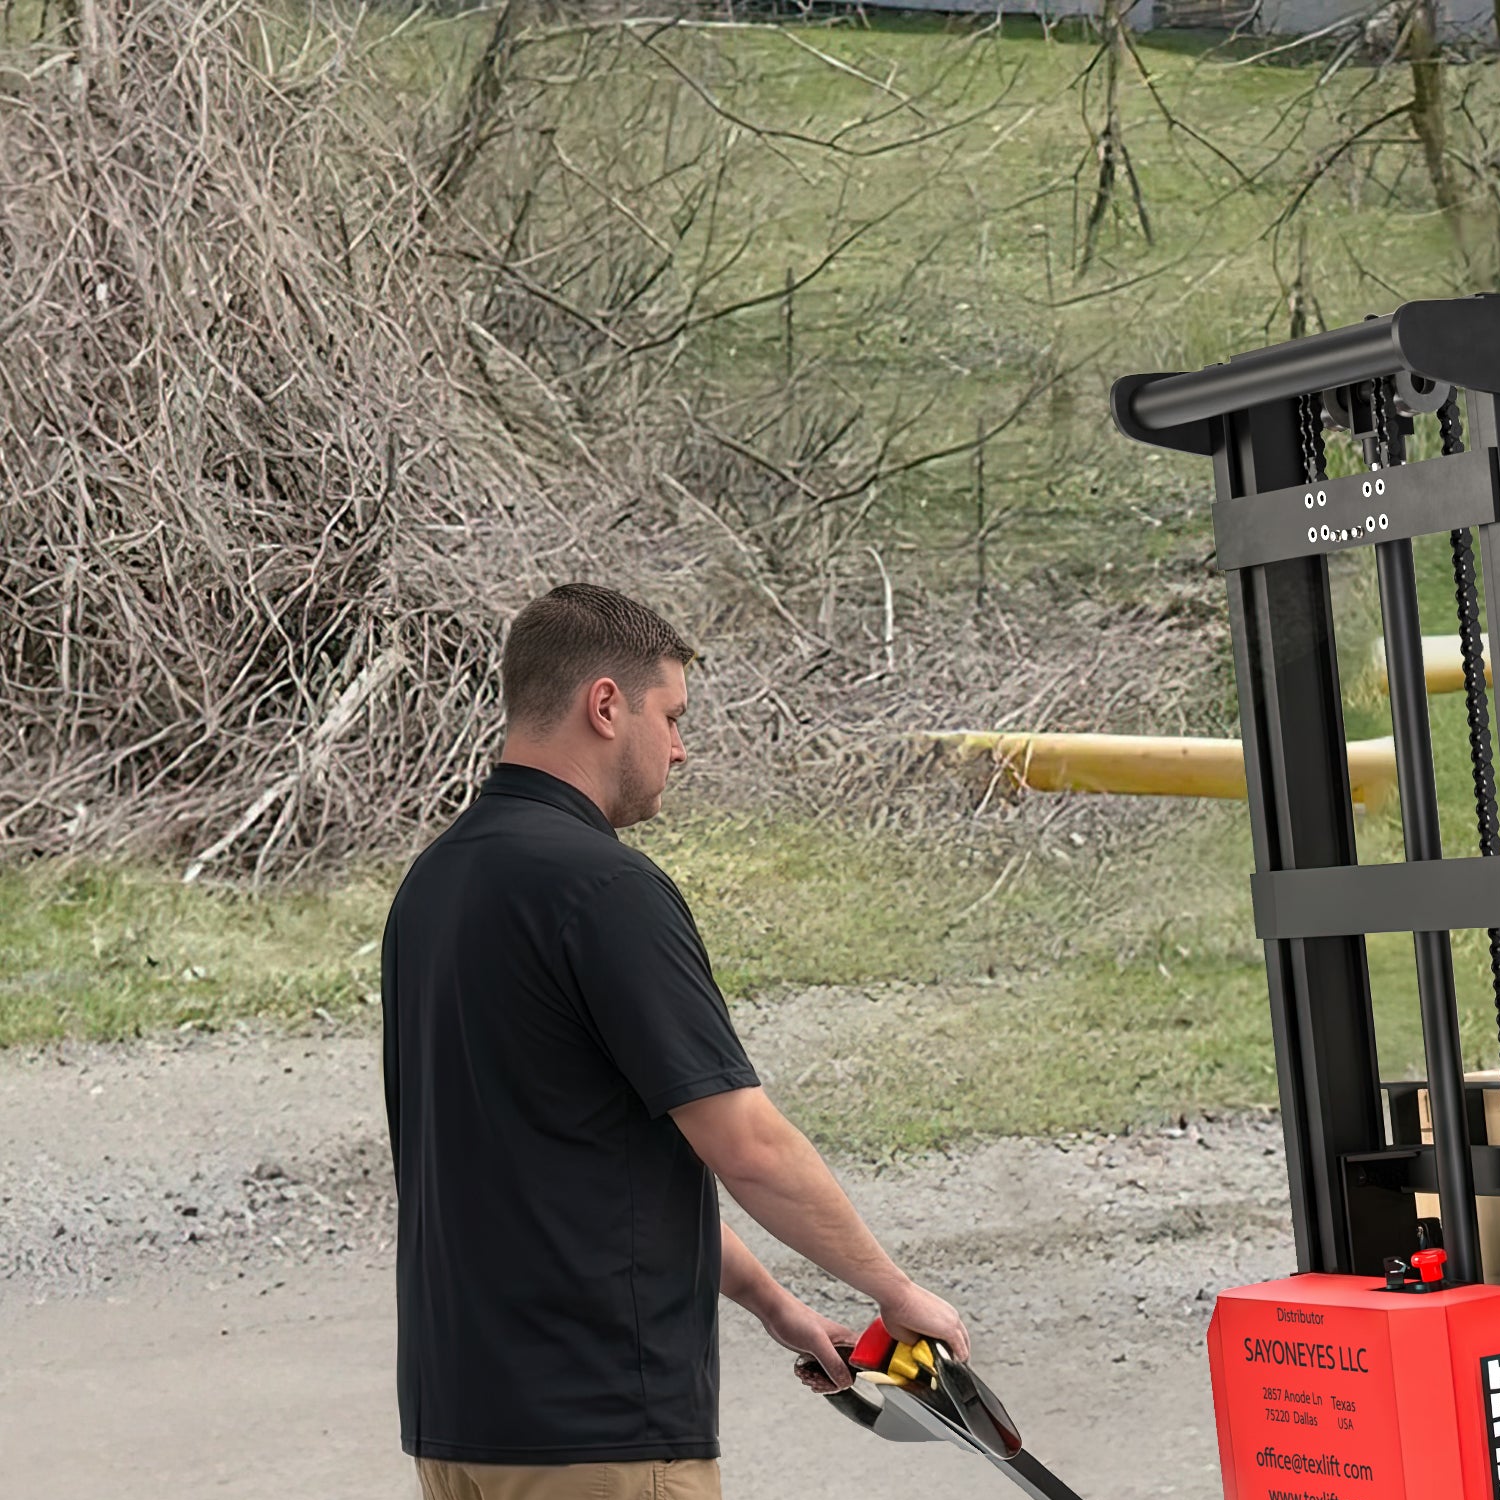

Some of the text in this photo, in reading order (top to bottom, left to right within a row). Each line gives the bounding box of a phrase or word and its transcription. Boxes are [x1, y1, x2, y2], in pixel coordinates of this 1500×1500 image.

[1276, 1307, 1325, 1325] Distributor
[1243, 1337, 1369, 1373] SAYONEYES LLC
[1262, 1386, 1356, 1413] 2857 Anode Ln Texas
[1265, 1408, 1355, 1431] 75220 Dallas USA
